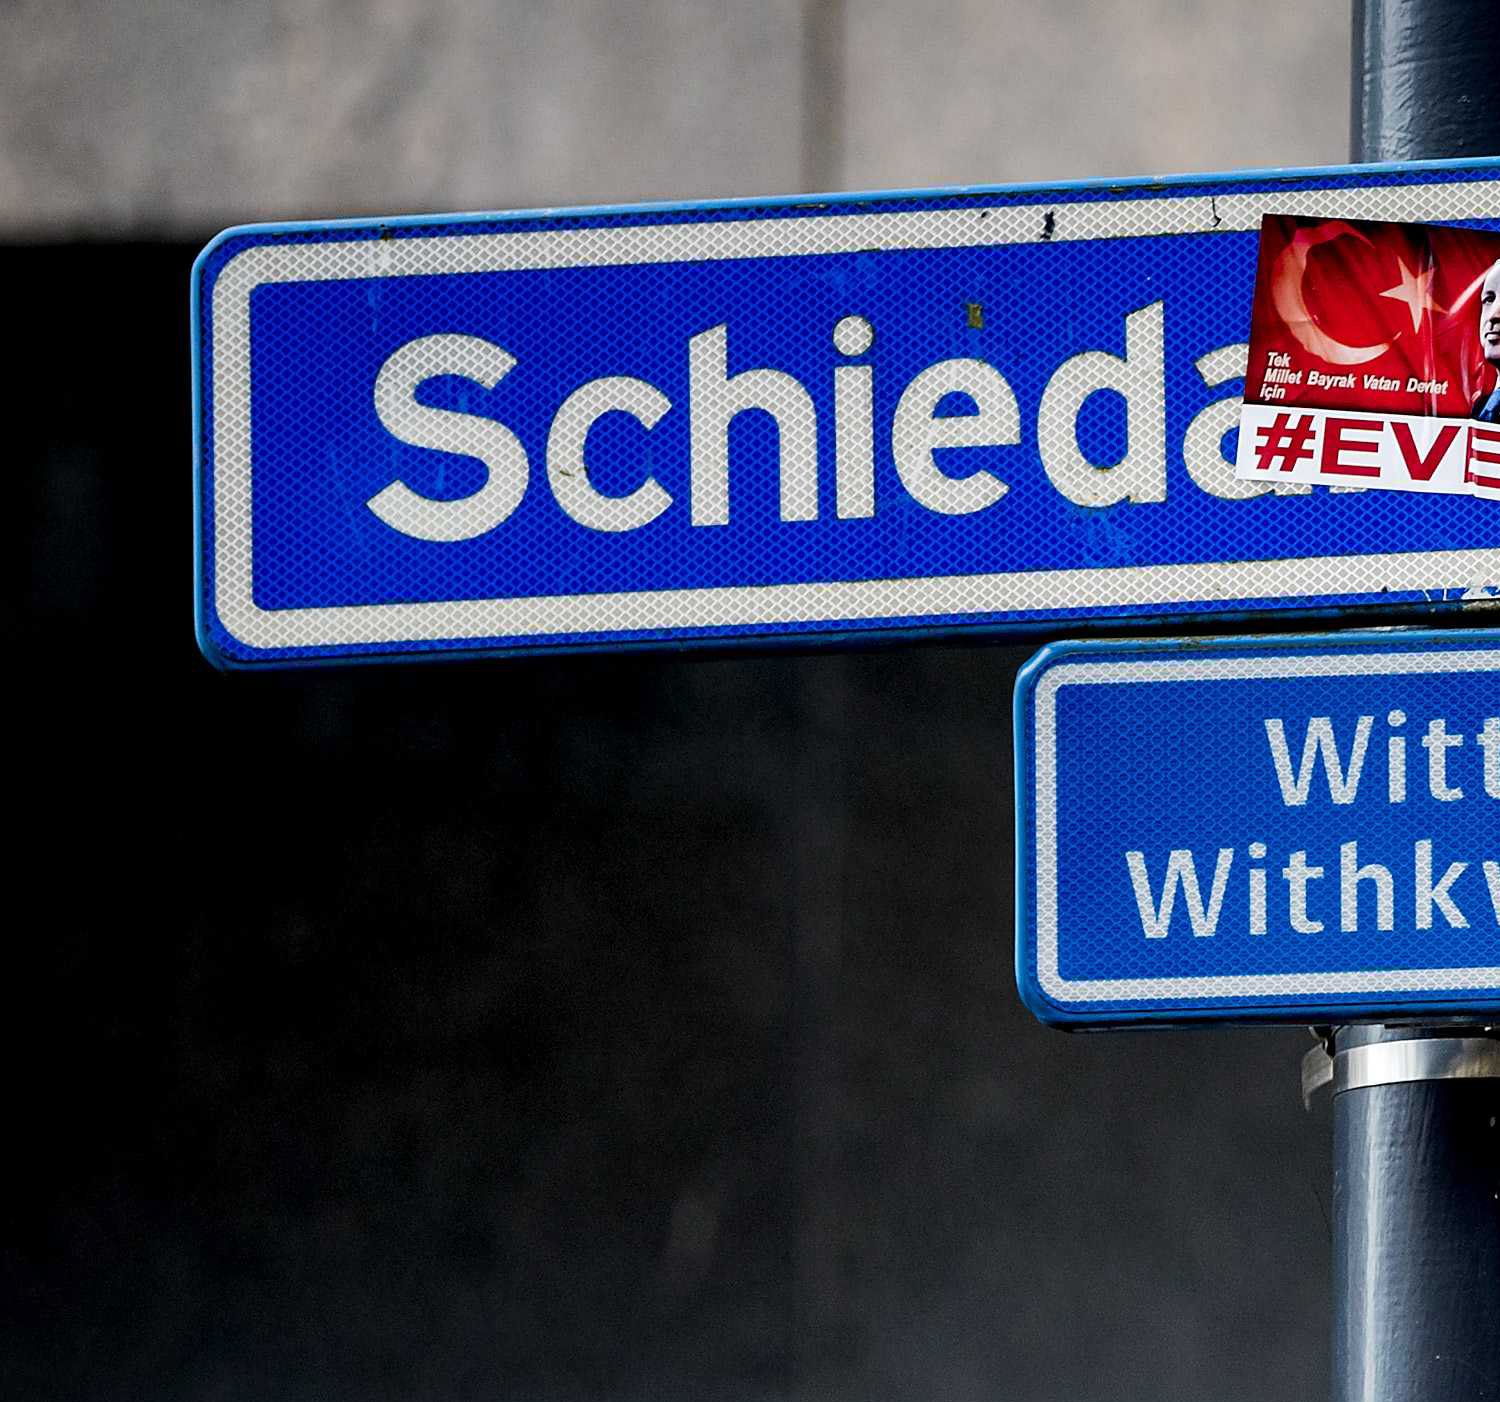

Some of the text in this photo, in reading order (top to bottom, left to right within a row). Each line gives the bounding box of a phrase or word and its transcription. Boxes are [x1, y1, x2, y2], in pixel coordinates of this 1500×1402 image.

[1267, 351, 1291, 368] Tek
[1264, 368, 1449, 396] Millet Bayrak Vatan Devlet
